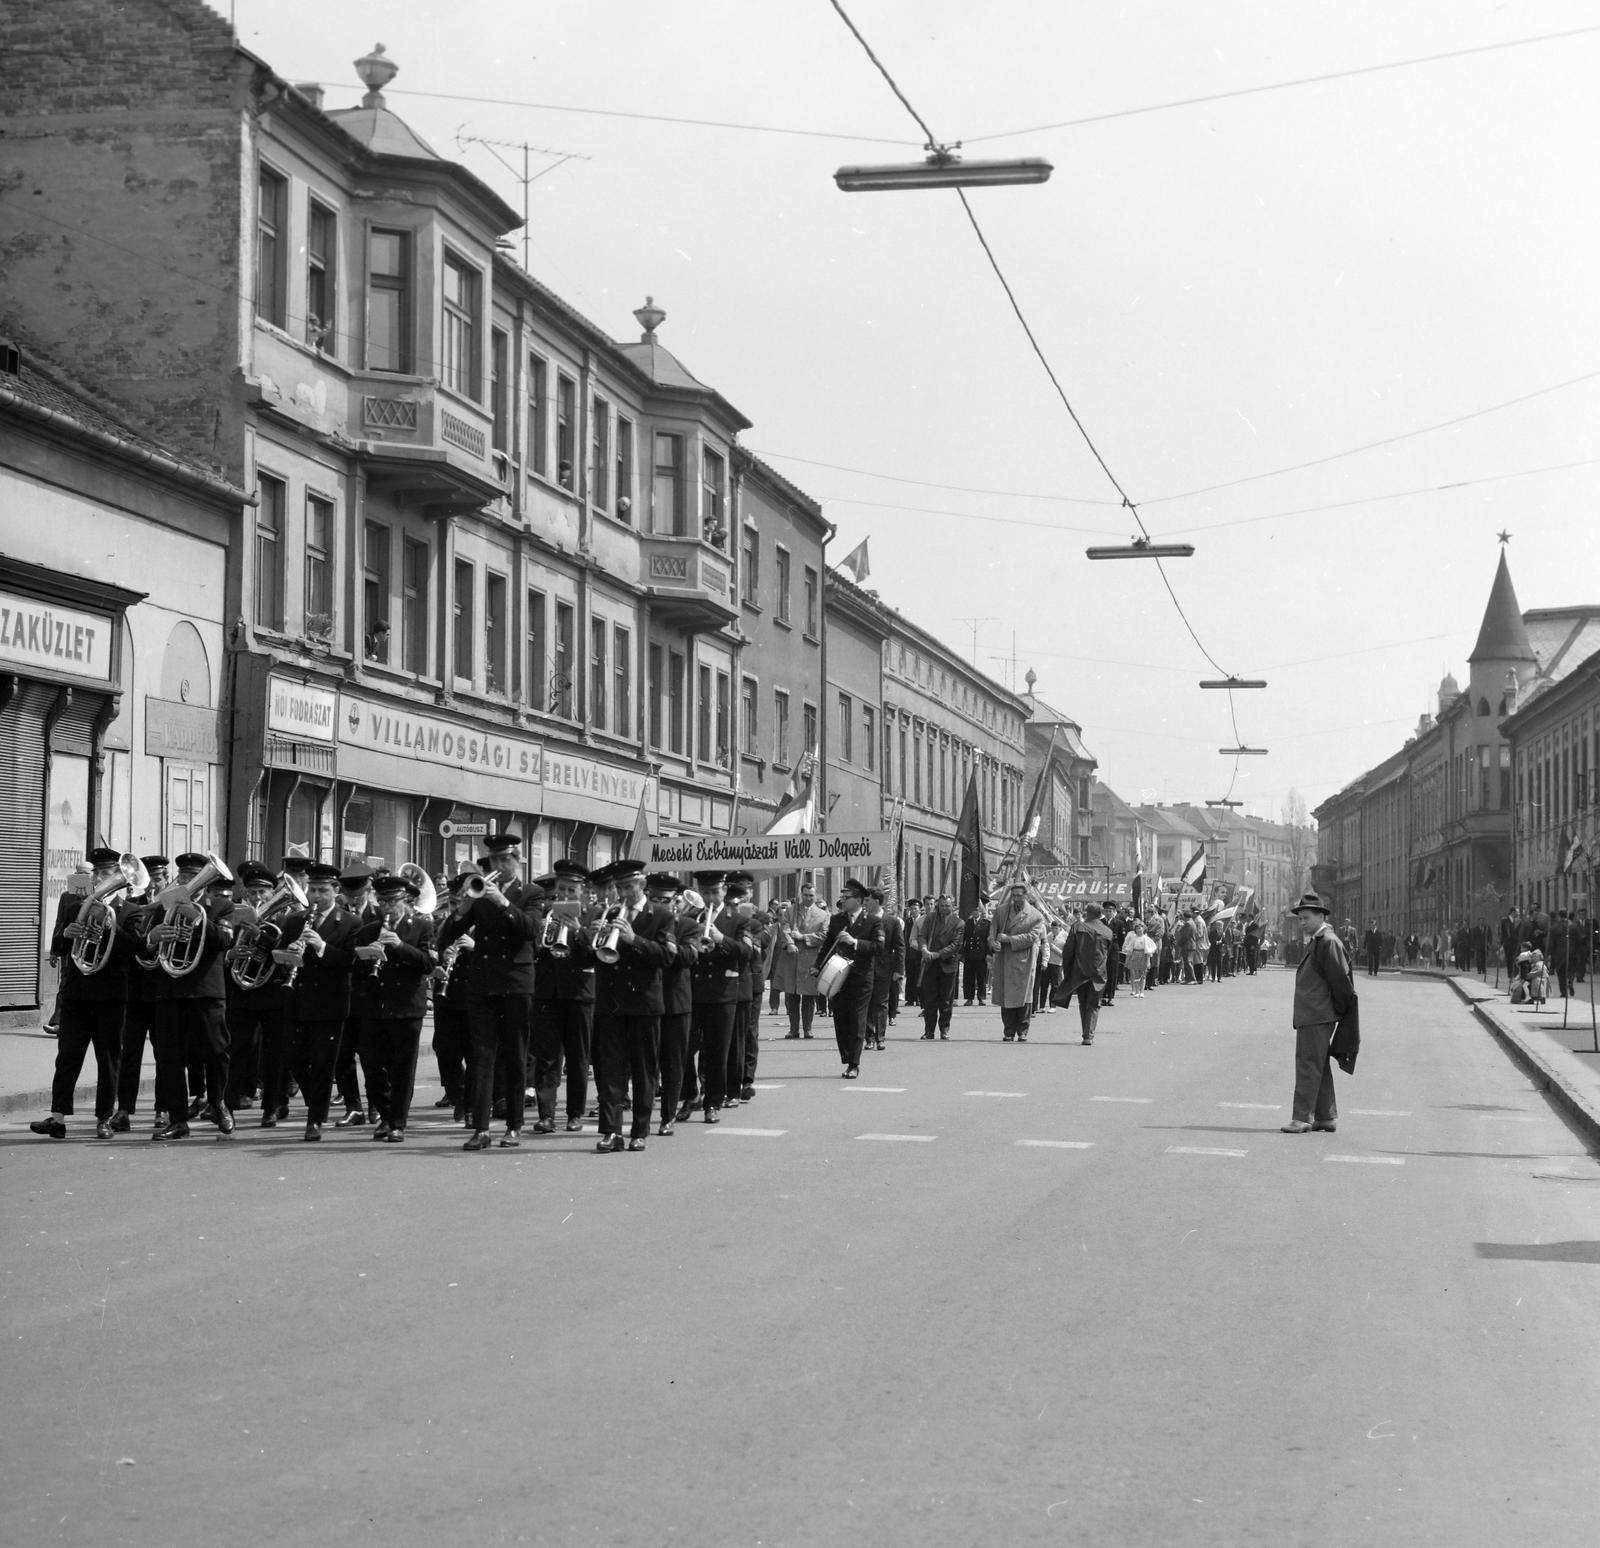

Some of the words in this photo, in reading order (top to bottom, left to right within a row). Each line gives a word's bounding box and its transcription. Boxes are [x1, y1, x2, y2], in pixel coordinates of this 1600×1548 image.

[0, 607, 96, 664] ZAKÜZLET
[290, 696, 332, 728] FODRÁSZAT
[371, 713, 512, 770] VILLAMOSSÁGI
[519, 750, 638, 800] SZERELVÉNYEK
[456, 823, 485, 833] AUTÓBUSZ
[651, 843, 693, 863] Mecseki
[696, 838, 779, 865] Ércbányászati
[784, 838, 814, 860] Váll.
[818, 836, 872, 862] Dolgozói
